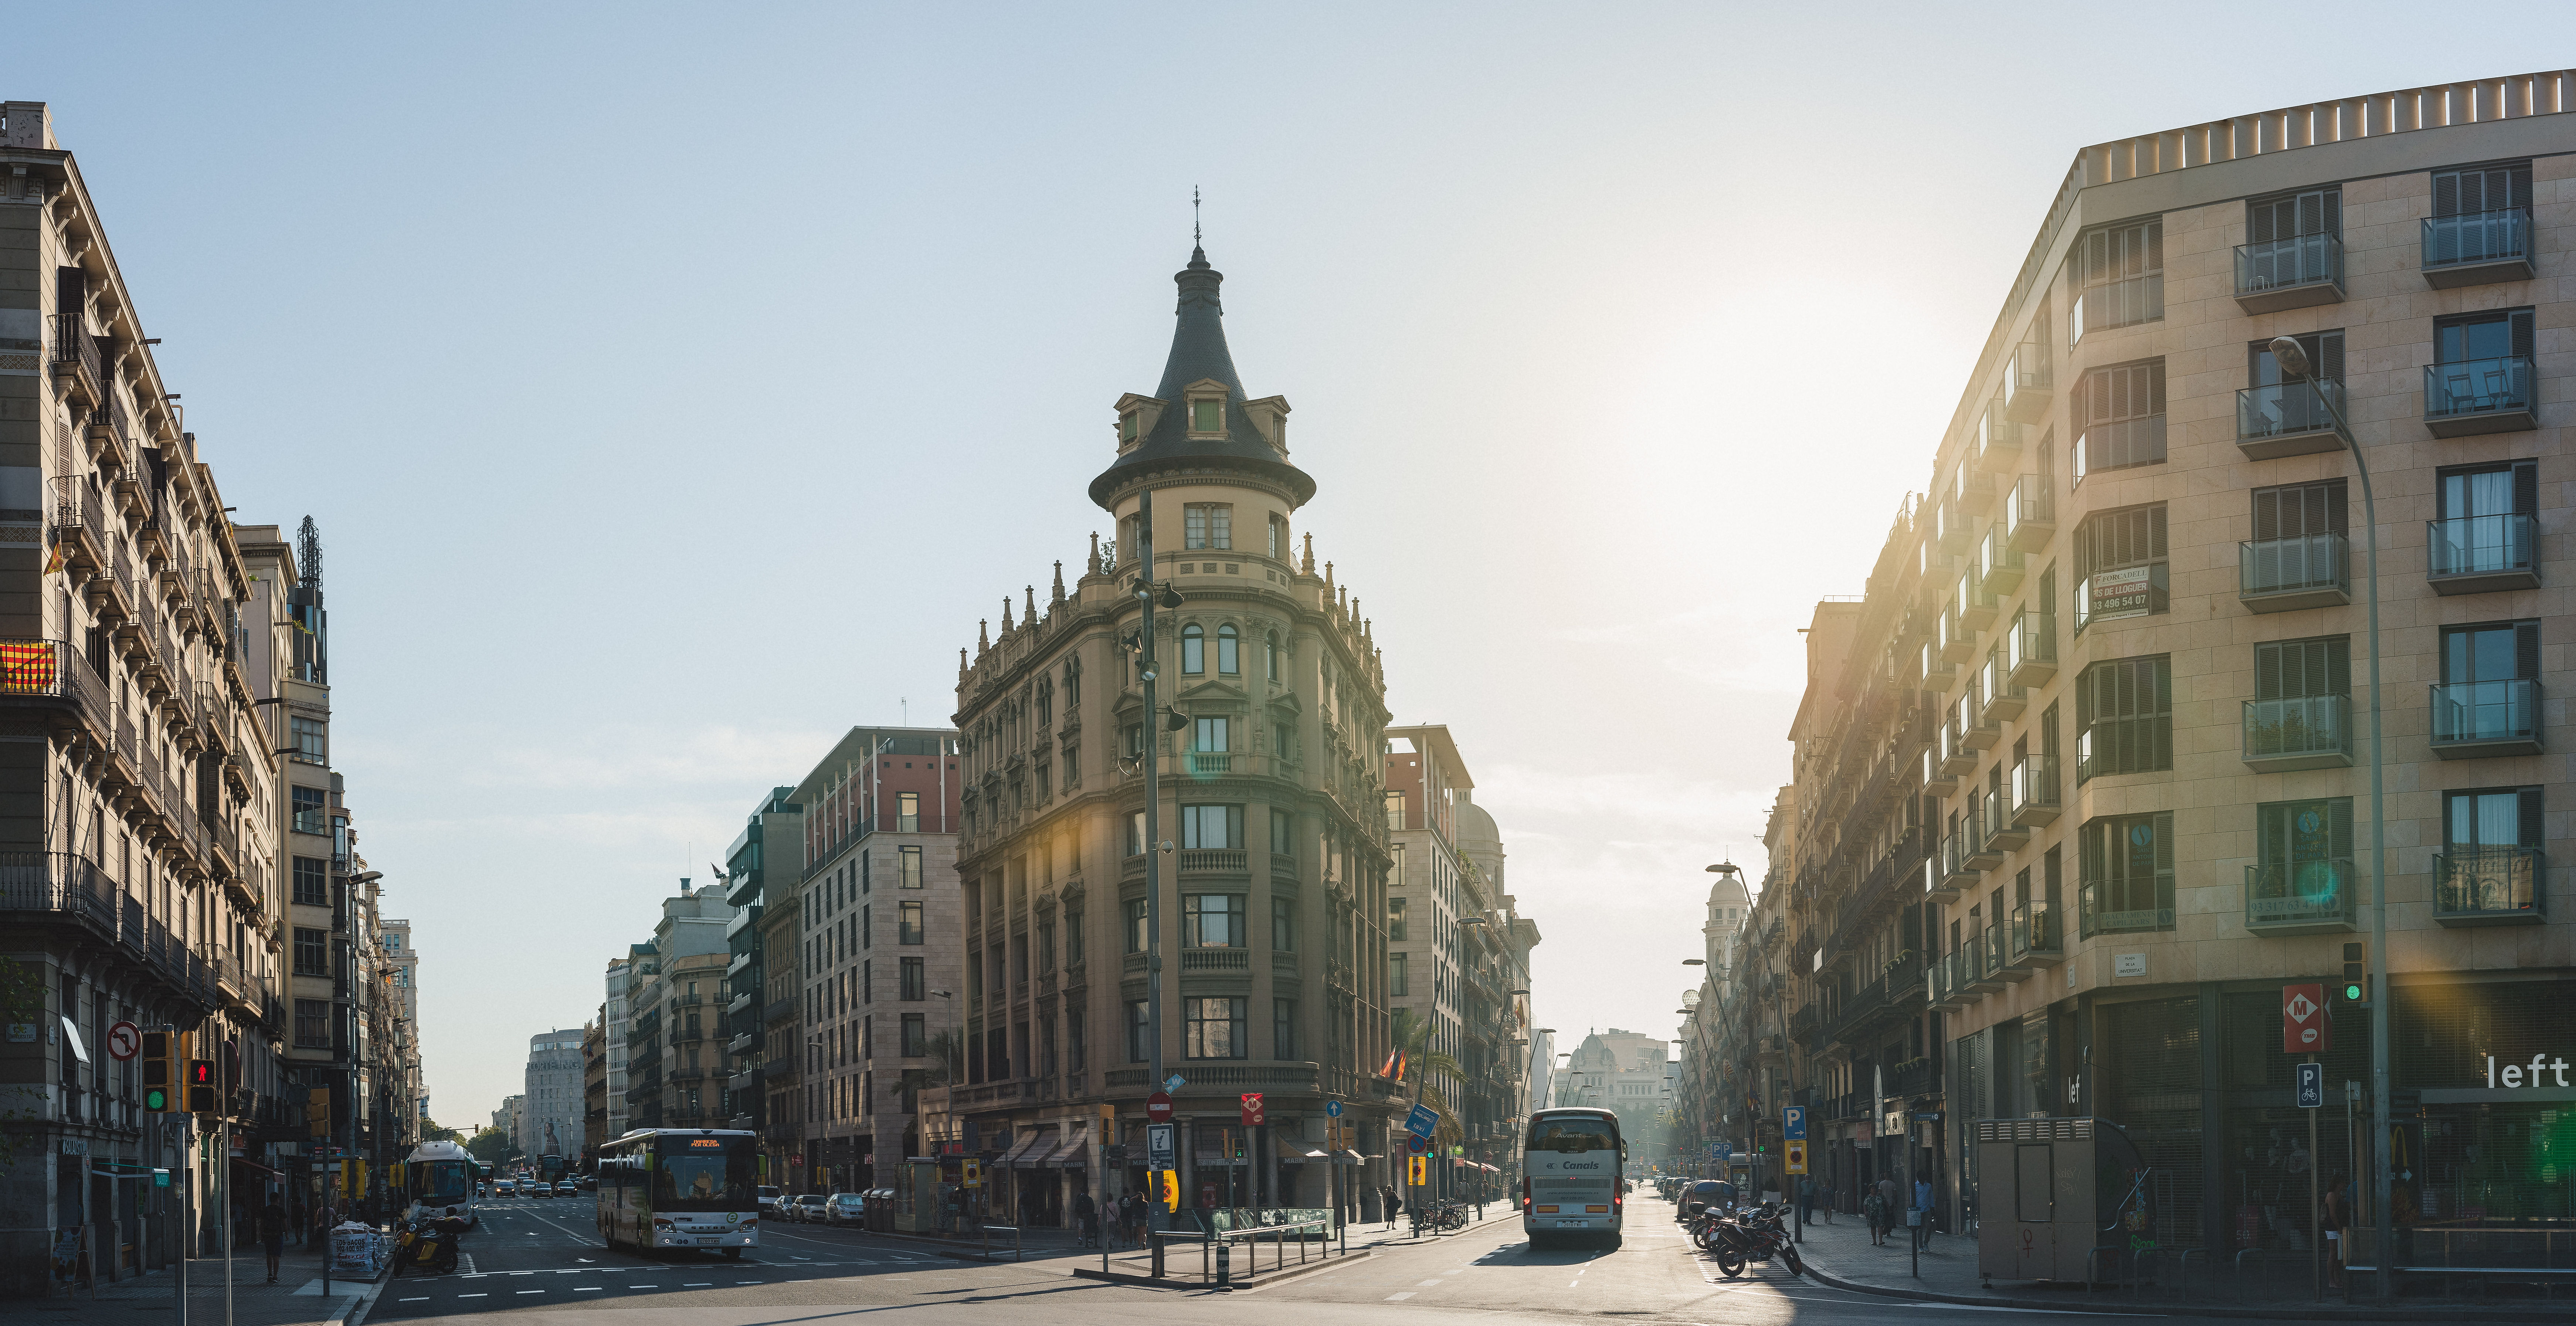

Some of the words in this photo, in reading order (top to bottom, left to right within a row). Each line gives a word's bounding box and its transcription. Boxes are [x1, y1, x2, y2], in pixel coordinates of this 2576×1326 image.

[2102, 570, 2146, 582] FORCADELL
[2105, 587, 2114, 596] DE
[2115, 583, 2146, 594] LLOGUER
[2094, 601, 2102, 610] 93
[2105, 598, 2119, 608] 496
[2122, 597, 2133, 606] 54
[2135, 595, 2146, 604] 07
[1782, 844, 1791, 909] HOTEL
[2251, 902, 2263, 912] 93
[2265, 901, 2284, 911] 317
[2287, 901, 2299, 910] 63
[2303, 899, 2315, 909] 47
[2101, 911, 2155, 920] TRACTAMENTS
[2294, 1001, 2307, 1016] M
[530, 1061, 555, 1071] CORTE
[2488, 1054, 2569, 1088] left
[2304, 1070, 2313, 1085] P
[1787, 1109, 1800, 1127] P
[1413, 1122, 1425, 1132] taxi
[1724, 1144, 1730, 1153] P
[1563, 1161, 1599, 1169] Canals
